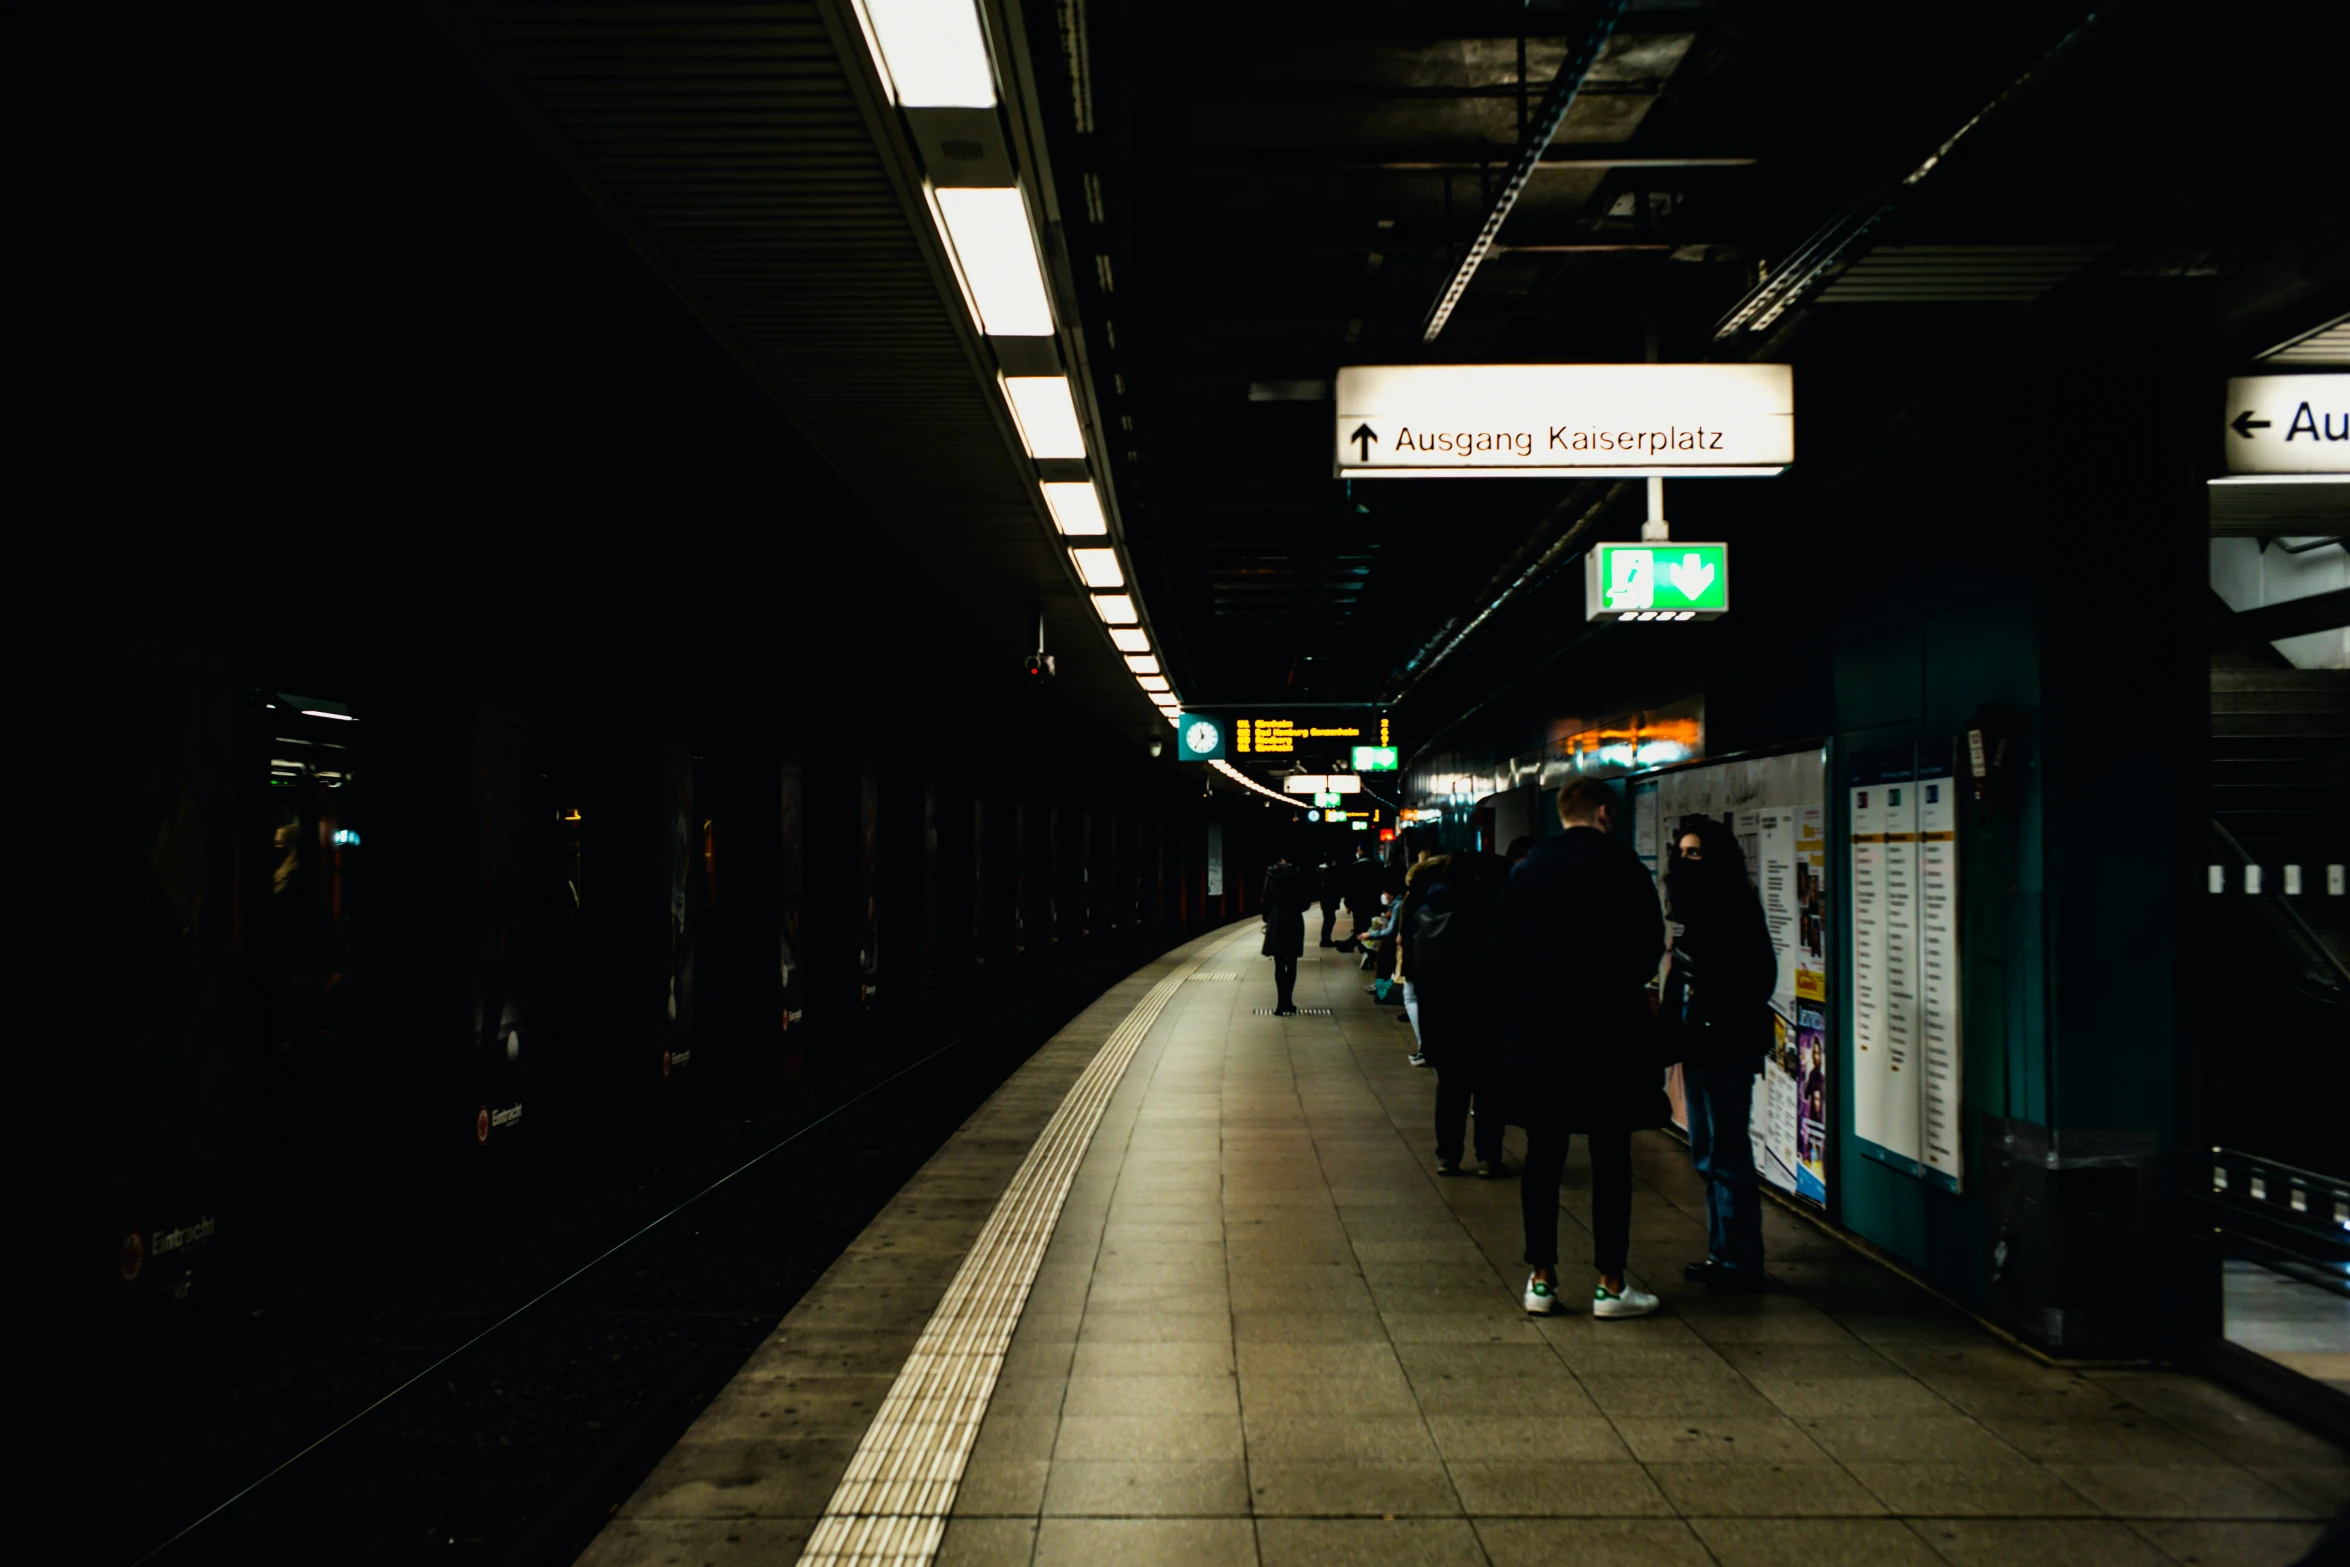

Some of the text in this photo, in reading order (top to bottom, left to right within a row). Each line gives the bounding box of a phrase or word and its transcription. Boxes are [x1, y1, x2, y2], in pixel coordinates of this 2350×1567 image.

[1395, 425, 1724, 457] Ausgang Kaiserplatz
[2285, 401, 2349, 441] Au
[151, 1215, 216, 1257] Eintracht
